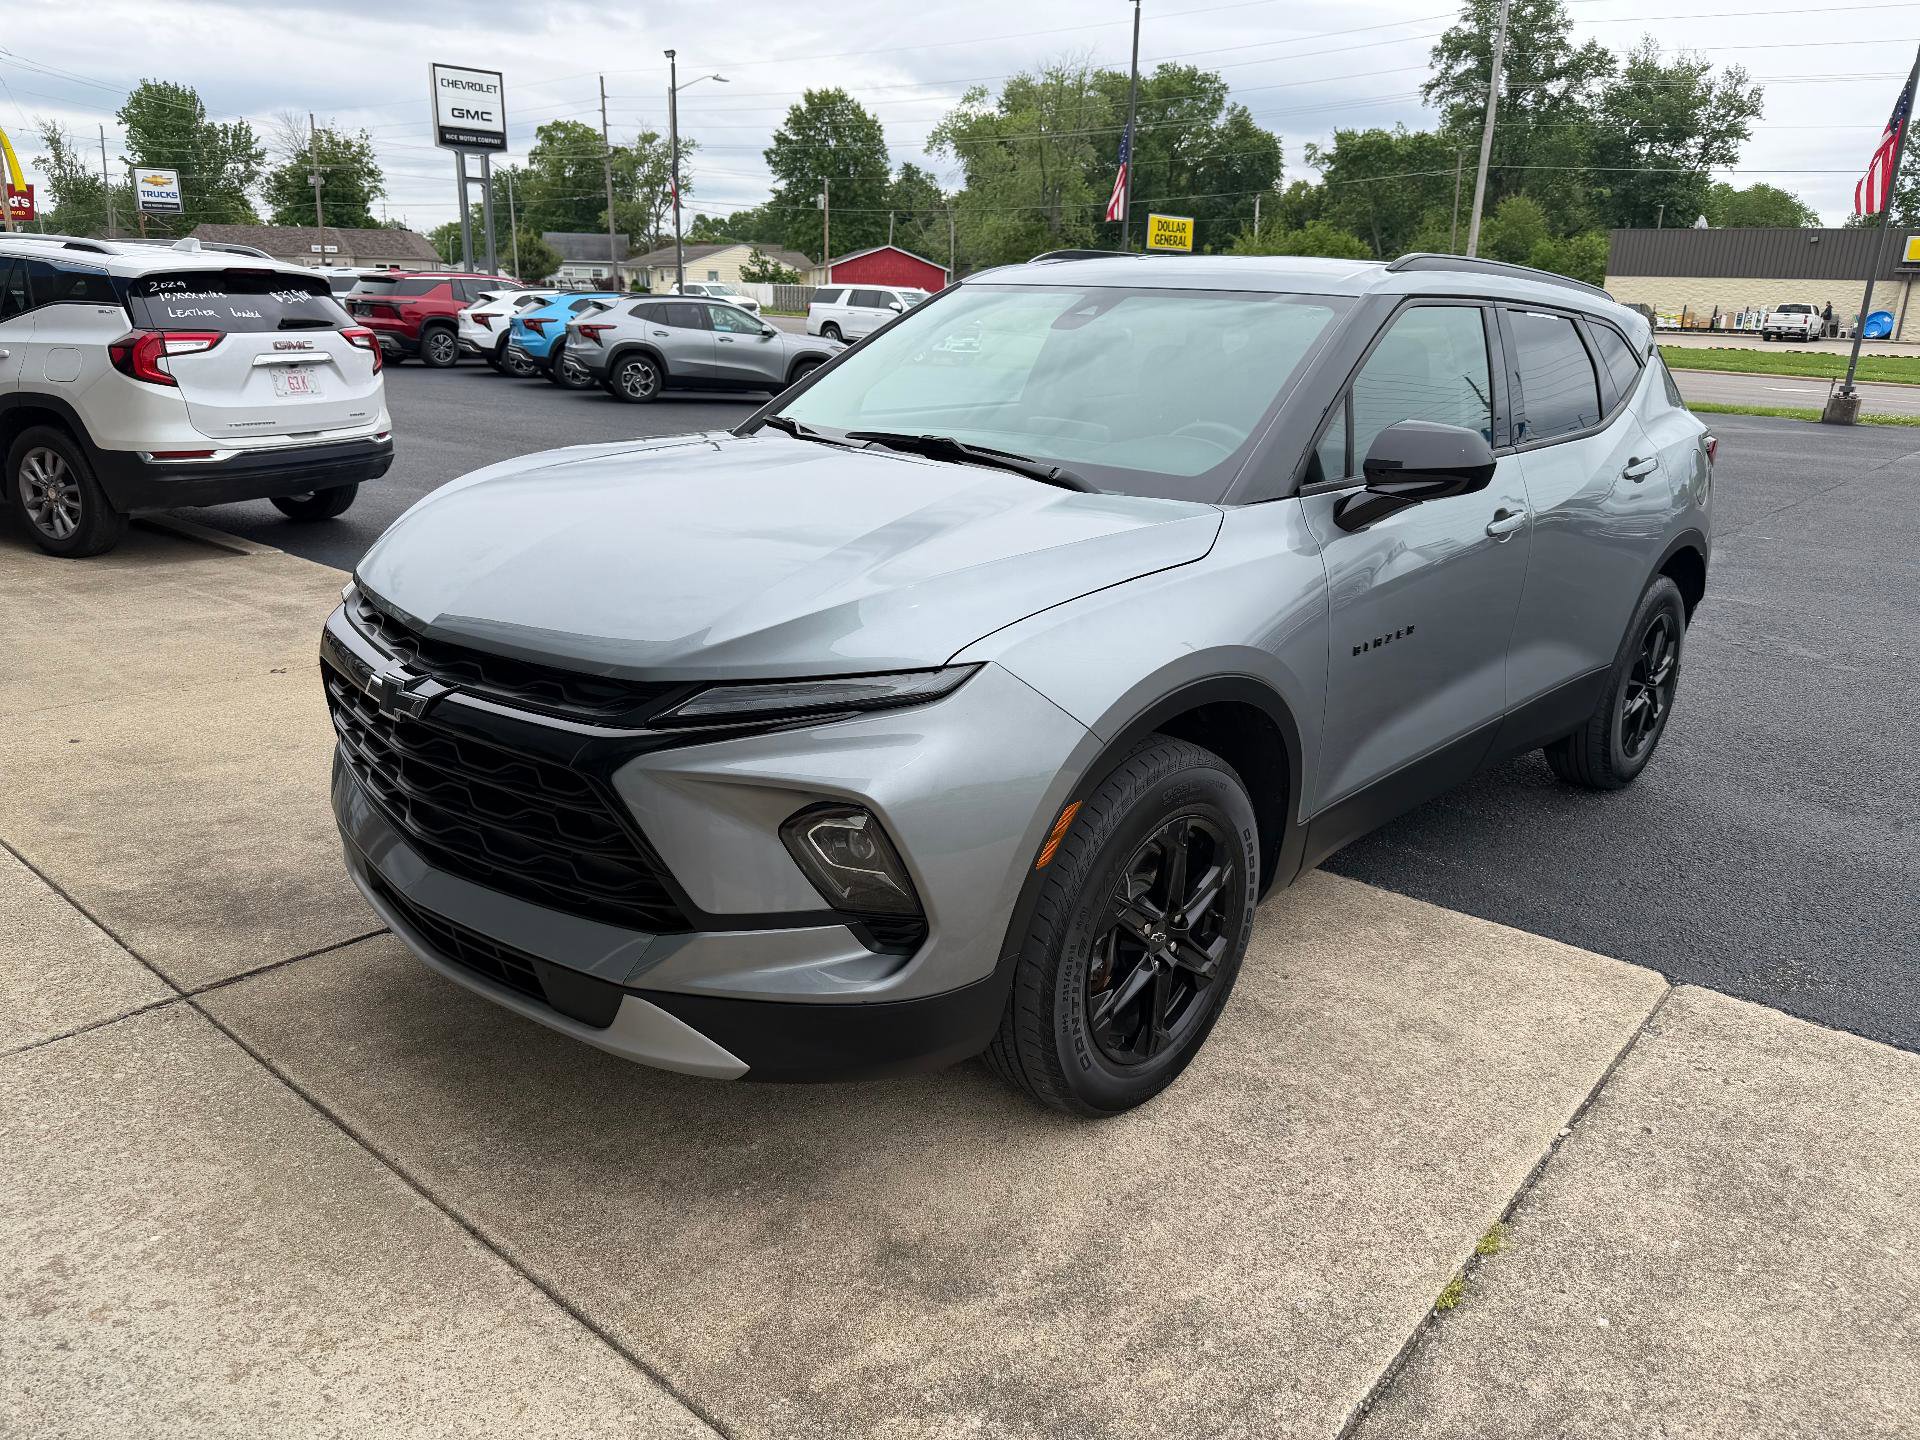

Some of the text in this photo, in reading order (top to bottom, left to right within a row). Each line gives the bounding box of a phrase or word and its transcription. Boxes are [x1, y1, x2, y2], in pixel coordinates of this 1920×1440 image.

[440, 77, 498, 94] CHEVROLET
[451, 107, 493, 122] GMC
[445, 133, 502, 145] RICE MOTOR COMPANY
[141, 190, 178, 199] TRUCKS
[1157, 220, 1186, 233] DOLLAR
[1154, 233, 1187, 246] GENERAL
[149, 281, 186, 292] 2024
[272, 340, 314, 351] GMC
[1352, 624, 1415, 656] BLAZER
